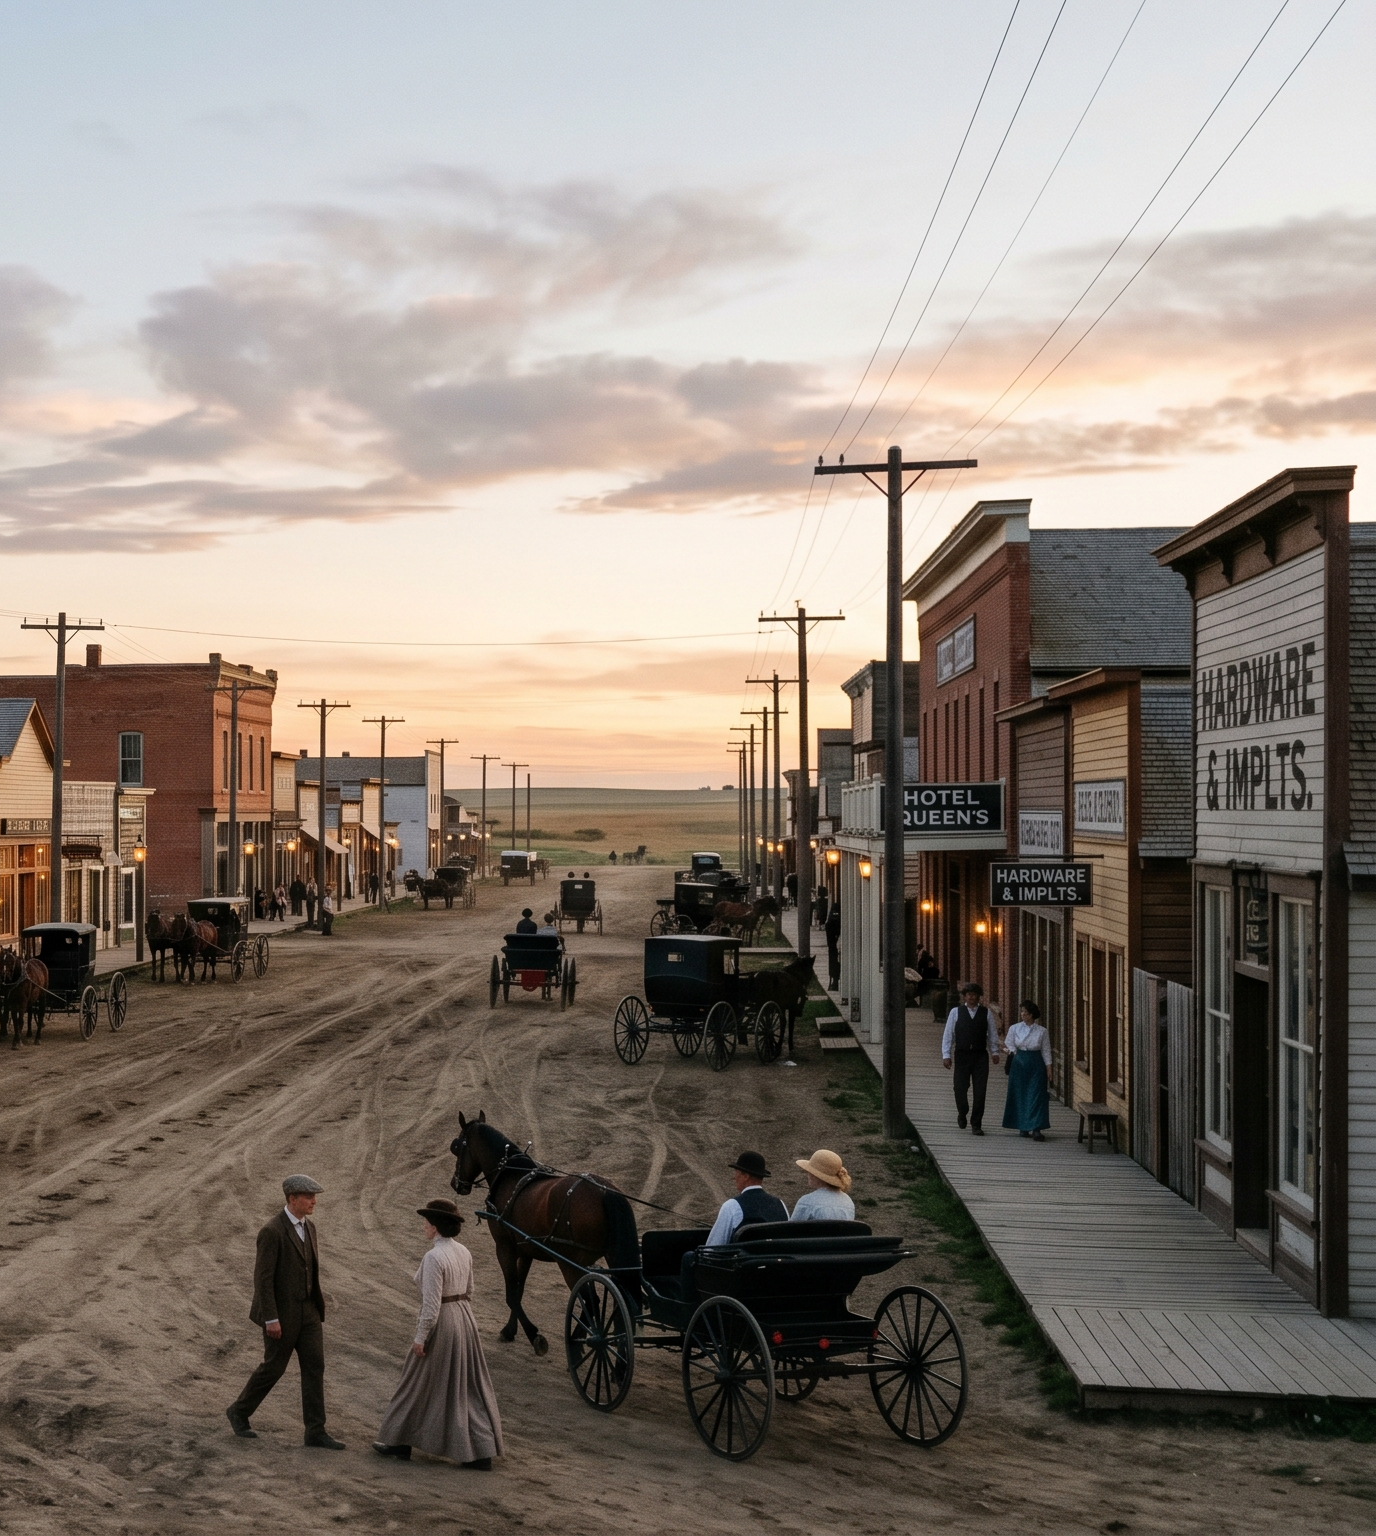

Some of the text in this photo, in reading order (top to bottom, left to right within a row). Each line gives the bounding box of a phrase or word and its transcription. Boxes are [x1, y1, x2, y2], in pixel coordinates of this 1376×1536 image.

[1202, 641, 1315, 731] HARDWARE
[1206, 739, 1313, 812] & IMPLTS.
[903, 789, 980, 806] HOTEL
[996, 869, 1086, 883] HARDWARE
[1002, 887, 1082, 901] & IMPLTS.
